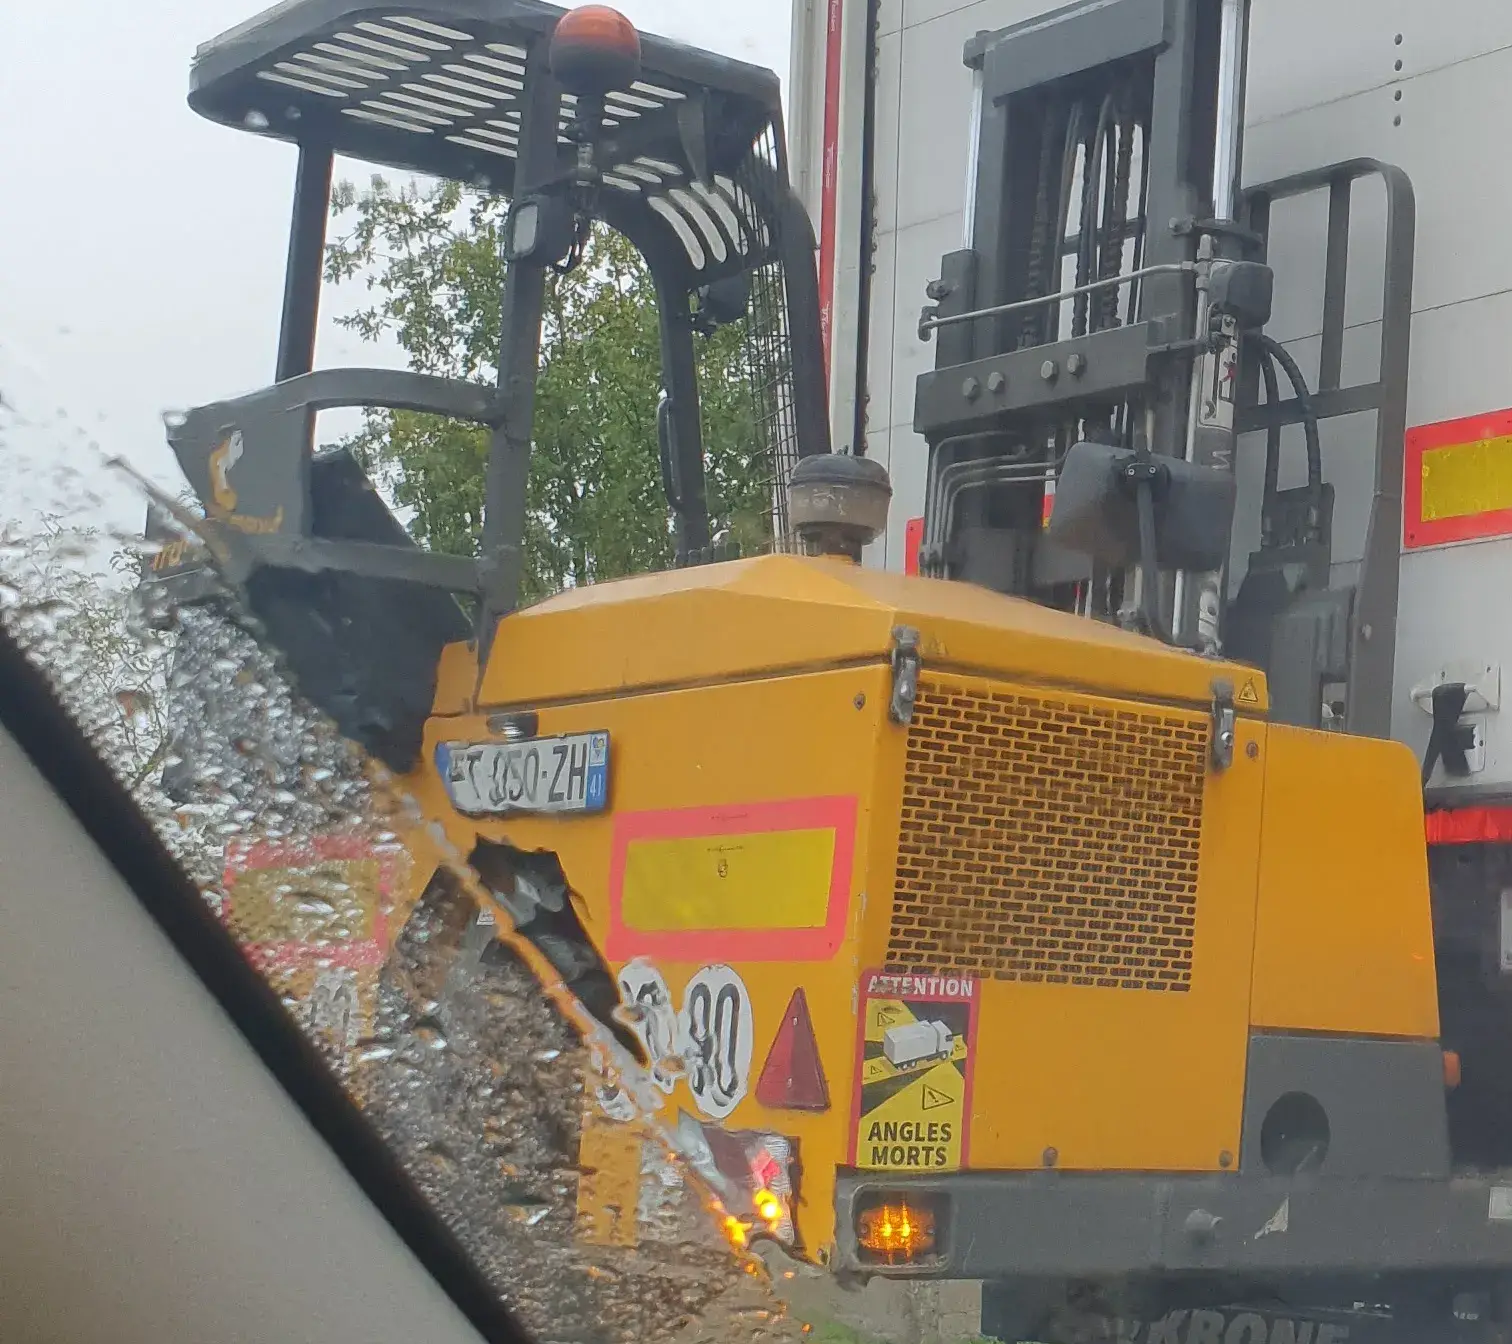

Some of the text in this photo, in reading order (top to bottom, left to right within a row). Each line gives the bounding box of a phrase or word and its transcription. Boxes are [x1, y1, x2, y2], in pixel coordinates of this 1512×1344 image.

[868, 975, 973, 996] ATTENTION
[868, 1121, 952, 1142] ANGLES
[872, 1146, 947, 1167] MORTS
